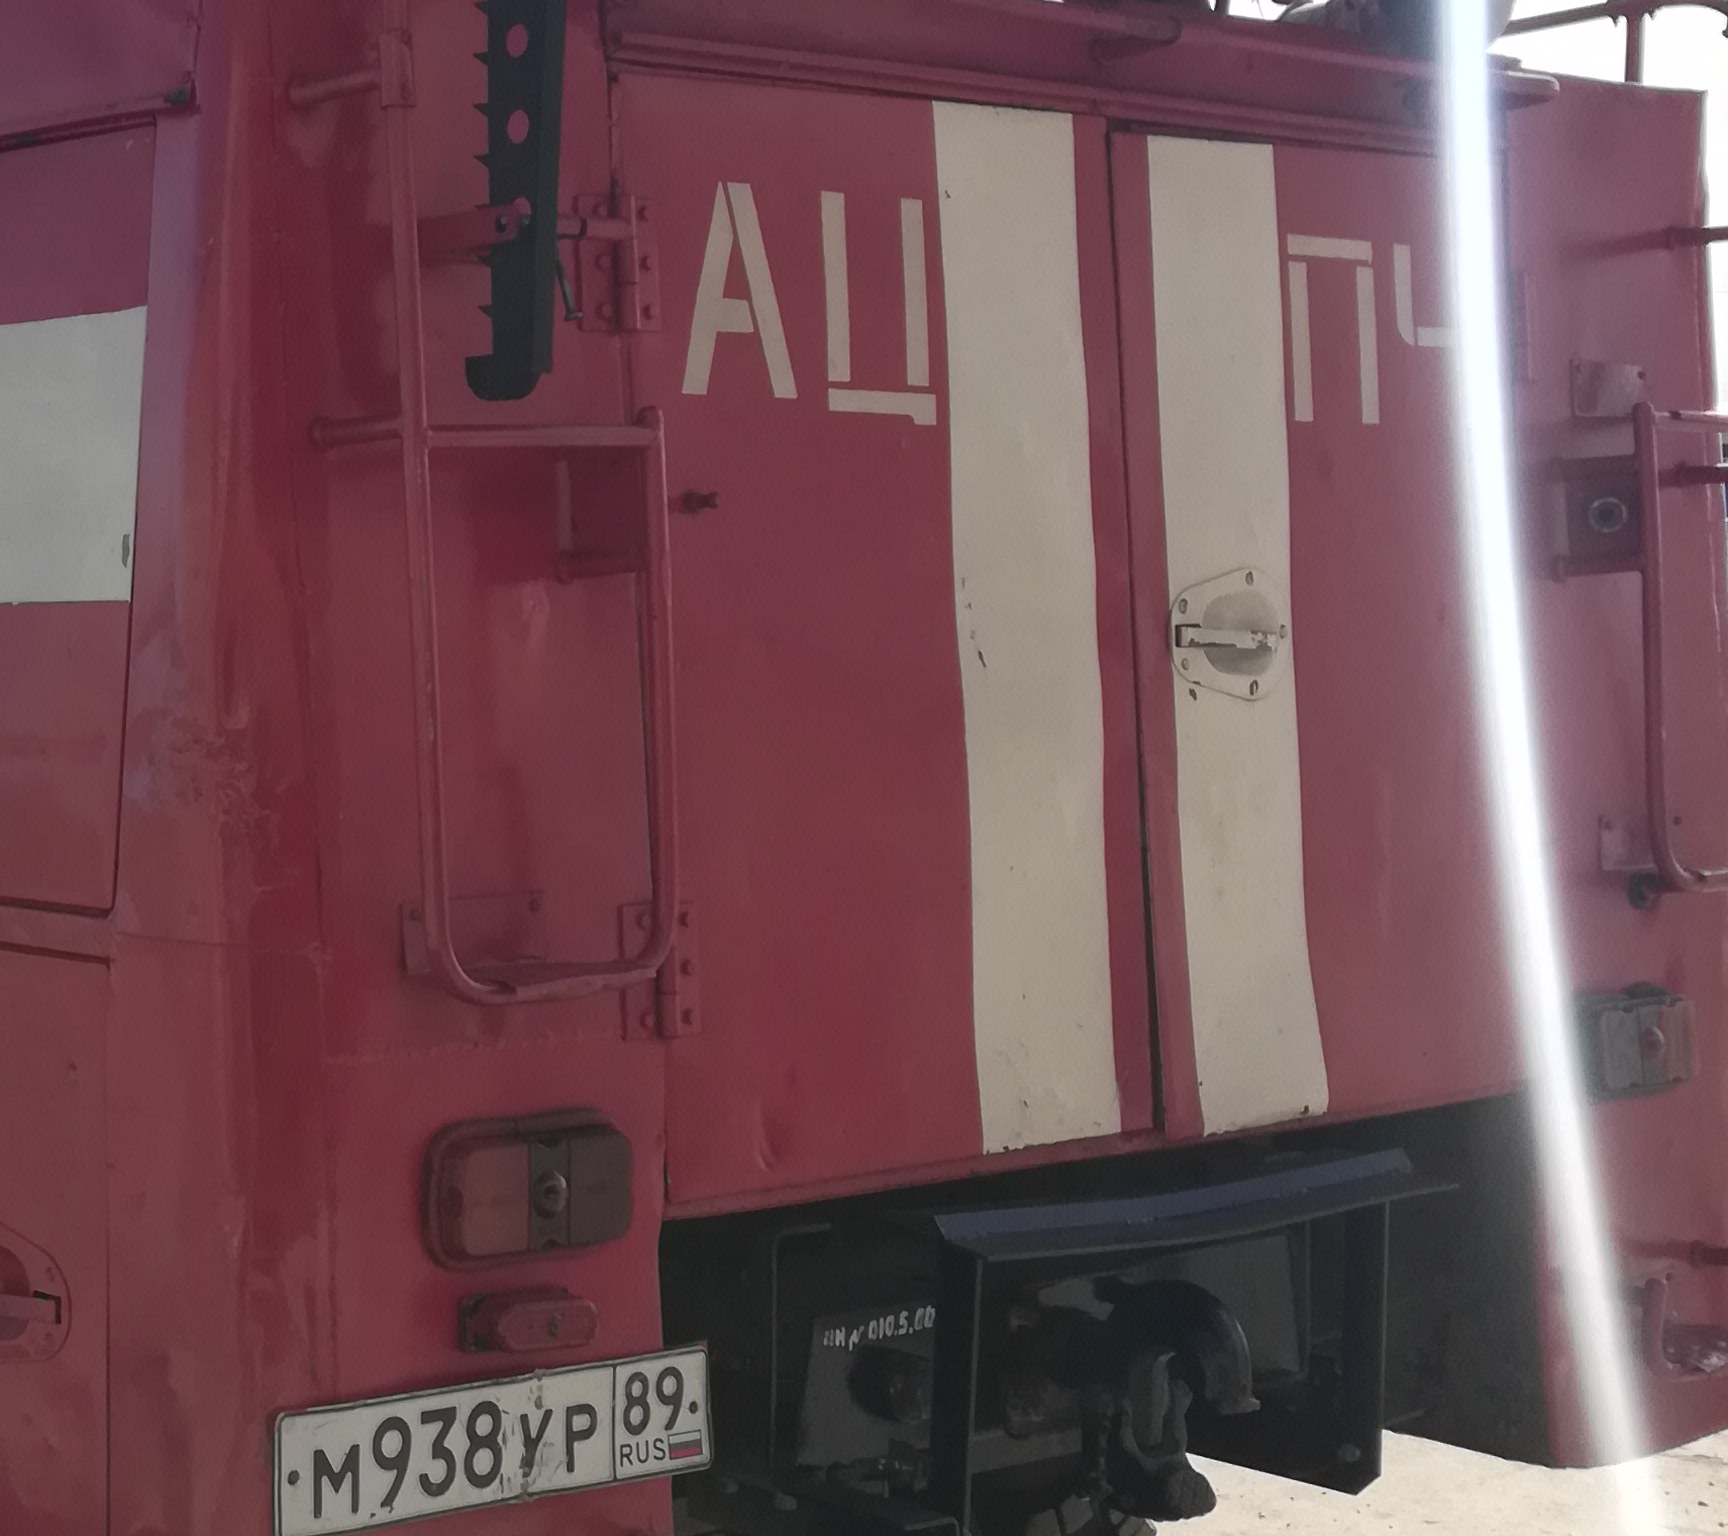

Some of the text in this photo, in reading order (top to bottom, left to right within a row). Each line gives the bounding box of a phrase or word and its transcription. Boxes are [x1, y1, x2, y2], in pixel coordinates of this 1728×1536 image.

[682, 181, 937, 425] АЦ
[313, 1366, 685, 1520] М938УР 89
[619, 1437, 667, 1468] RUS
